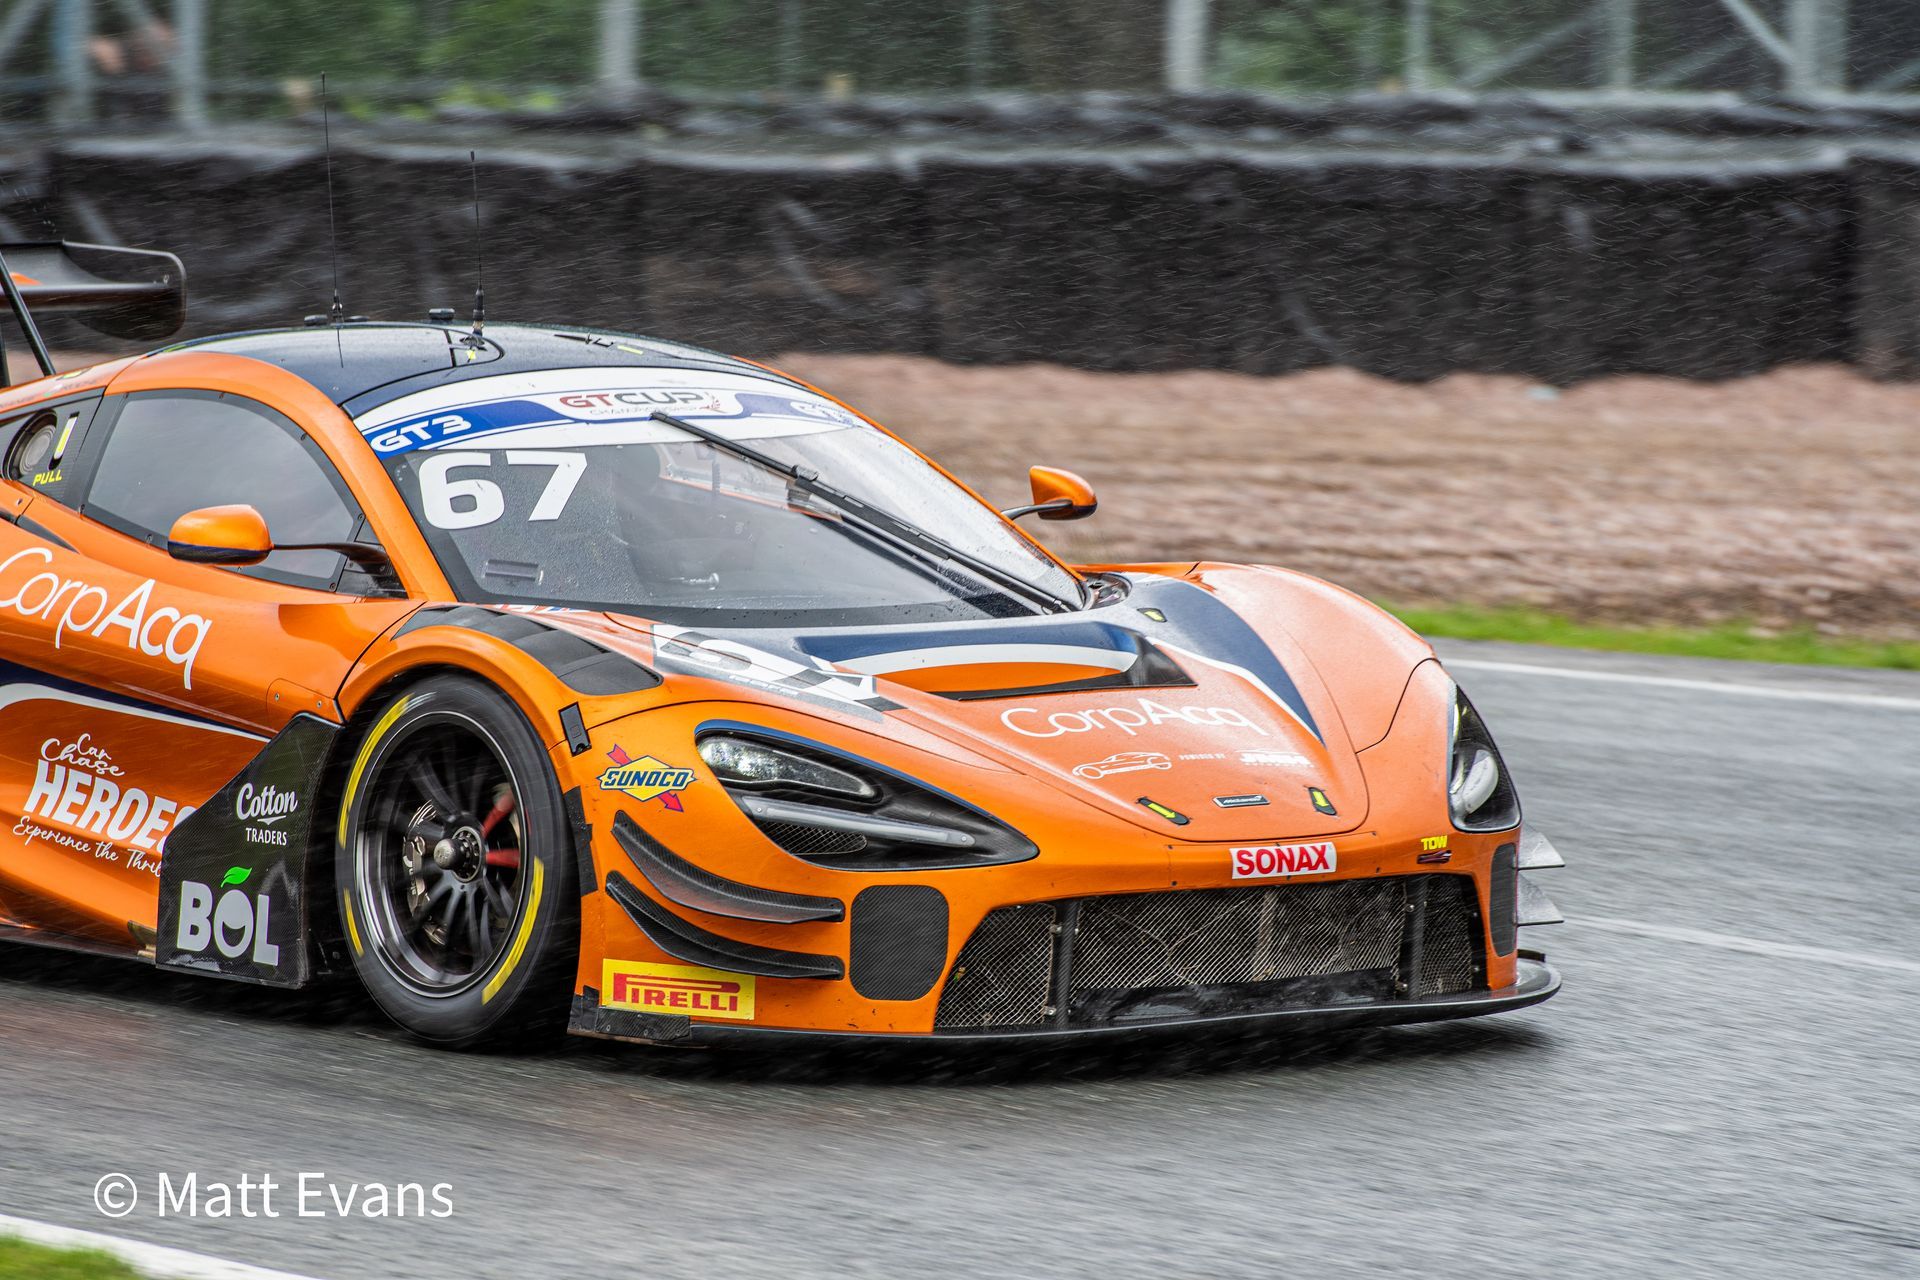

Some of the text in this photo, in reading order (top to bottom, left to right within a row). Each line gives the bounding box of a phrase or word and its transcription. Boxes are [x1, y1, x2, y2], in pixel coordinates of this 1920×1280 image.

[370, 415, 472, 452] GT3
[32, 470, 62, 487] PULL
[418, 450, 588, 530] 67
[0, 547, 213, 690] CorpAcq
[1000, 698, 1270, 738] CorpAcq
[41, 738, 125, 777] Chase
[77, 733, 112, 761] Car
[604, 770, 690, 787] SUNOCO
[236, 782, 298, 820] Cotton
[13, 815, 91, 846] Experience
[95, 841, 120, 861] the
[246, 827, 288, 846] TRADERS
[1421, 835, 1448, 851] TOW
[1236, 844, 1330, 876] SONAX
[177, 880, 280, 967] BOL
[613, 972, 741, 1012] PIRELLI
